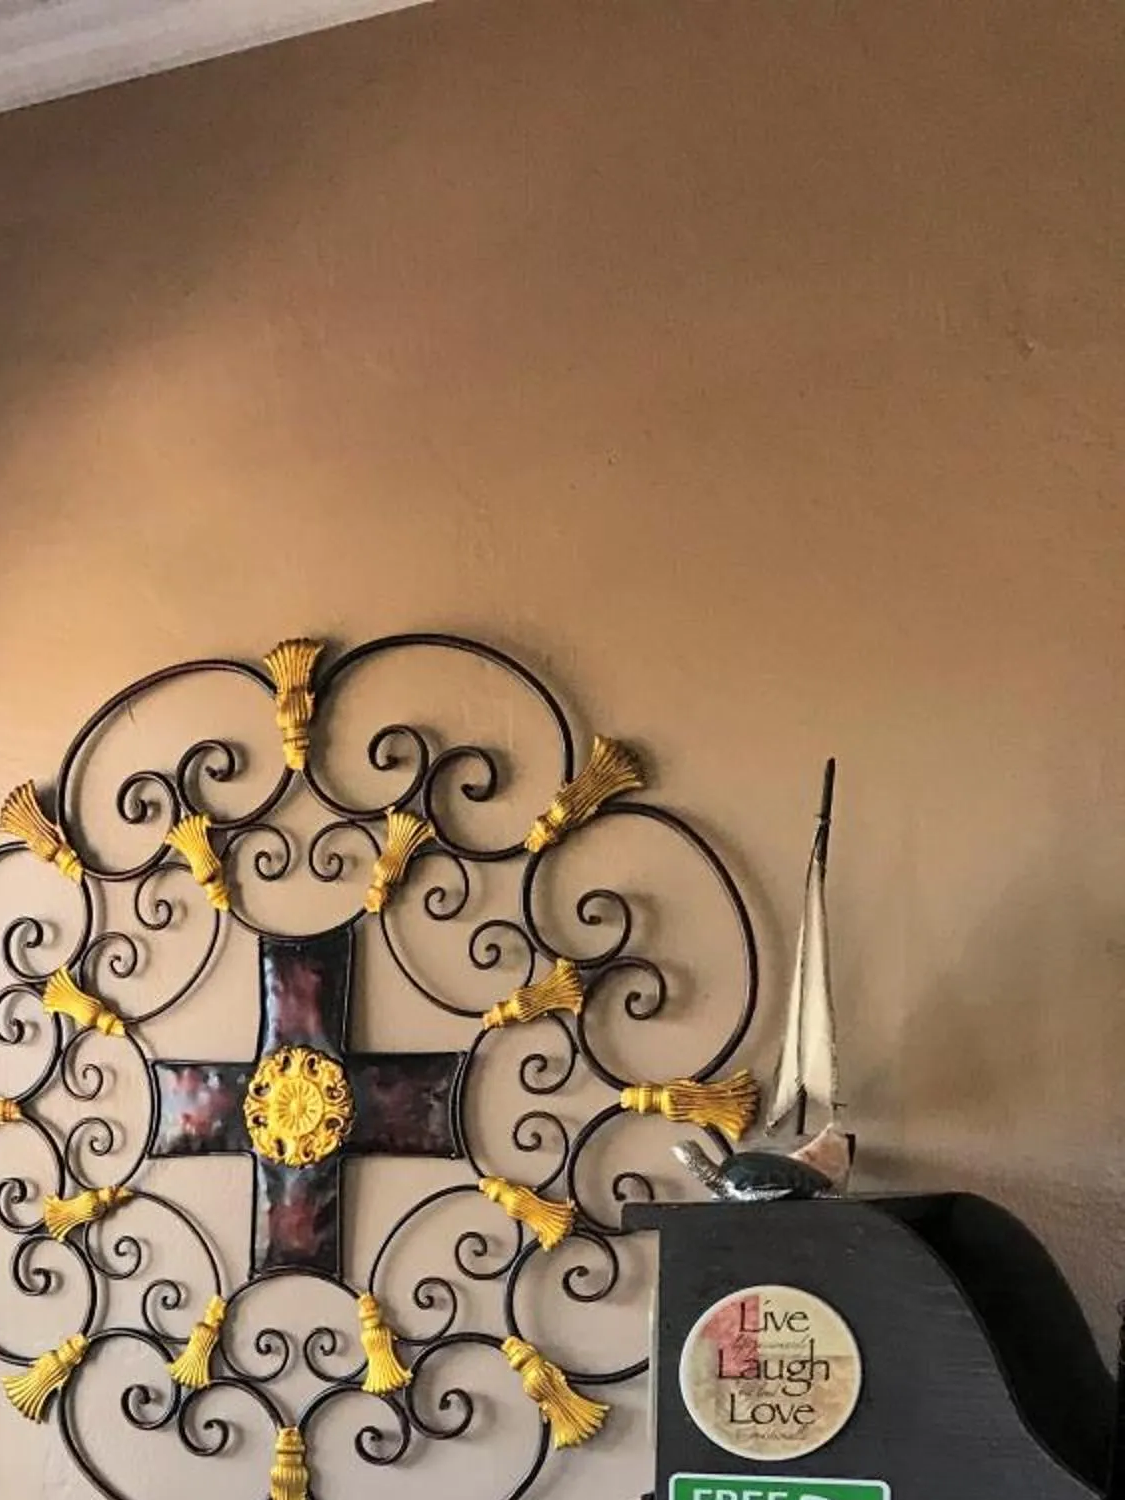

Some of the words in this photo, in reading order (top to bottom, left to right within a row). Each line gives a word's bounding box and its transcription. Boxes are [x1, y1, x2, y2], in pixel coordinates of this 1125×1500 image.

[739, 1300, 811, 1333] Live
[716, 1338, 831, 1396] Laugh
[729, 1393, 816, 1426] Love
